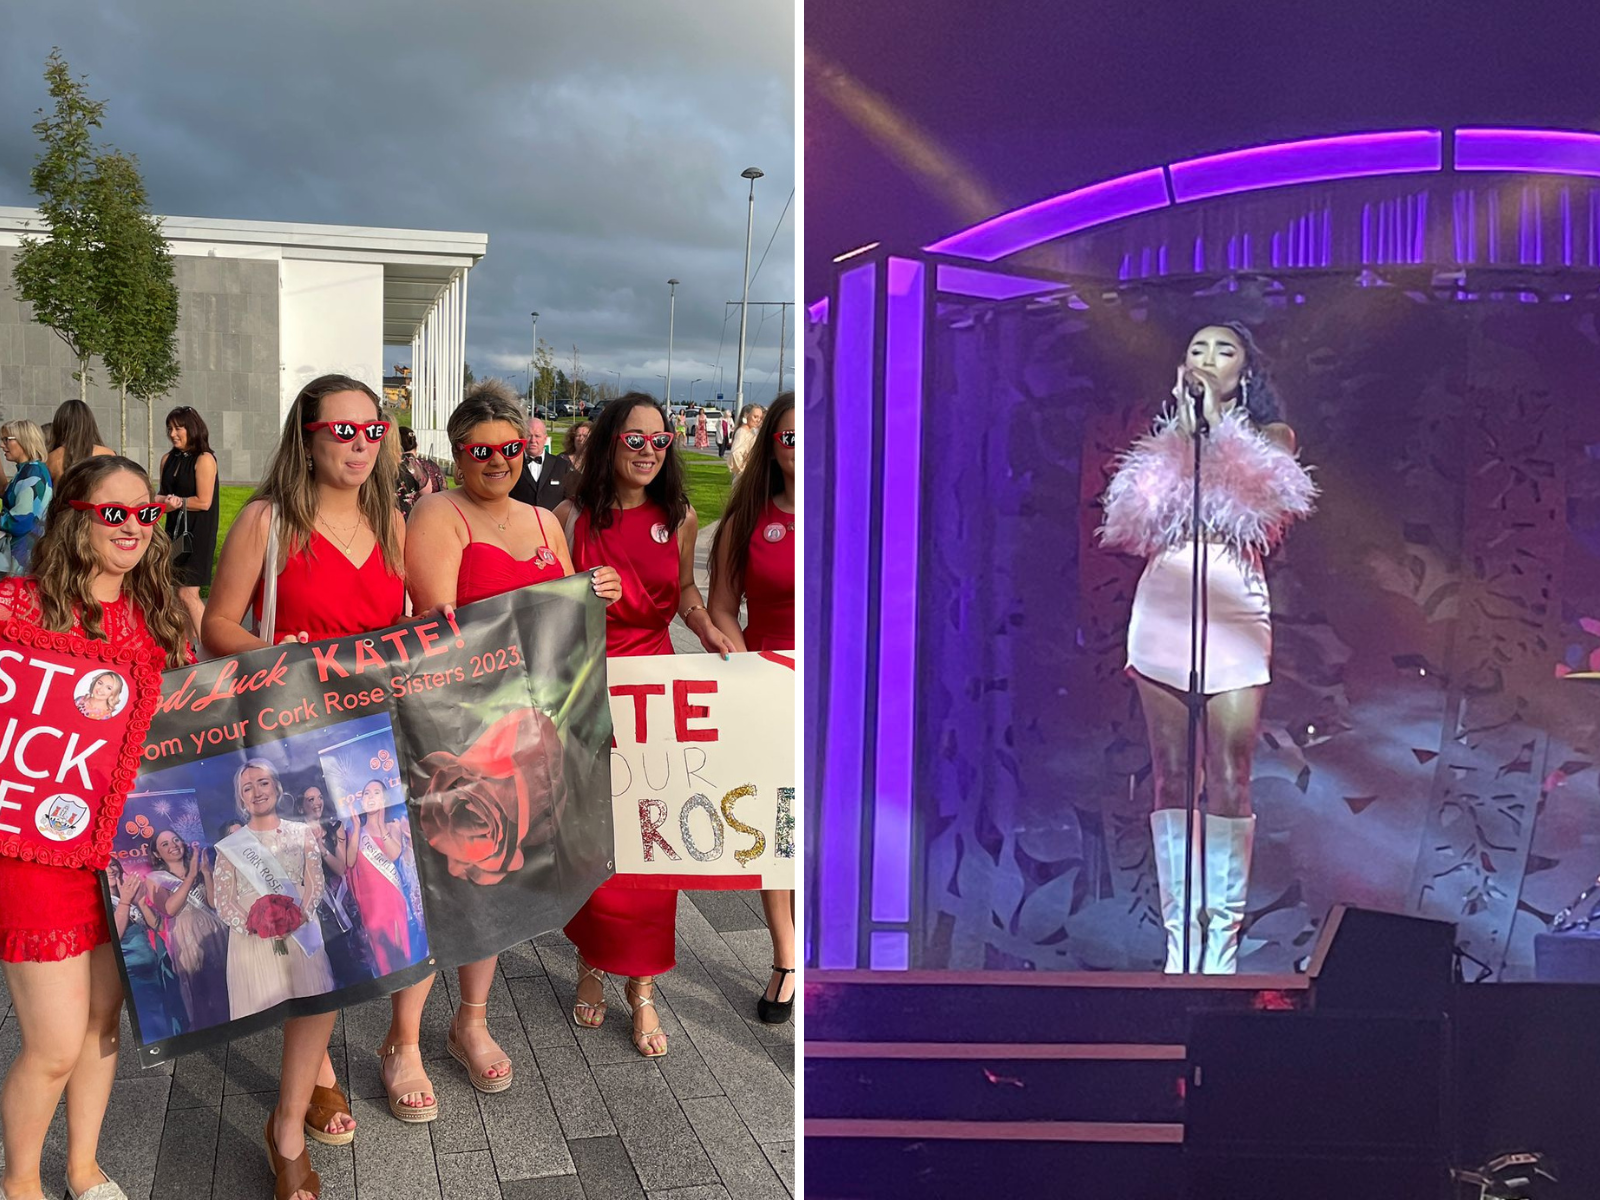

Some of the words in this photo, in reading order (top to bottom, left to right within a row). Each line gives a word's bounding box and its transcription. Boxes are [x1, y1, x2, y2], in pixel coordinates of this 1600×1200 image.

[189, 719, 249, 754] your
[257, 698, 319, 731] Cork
[323, 687, 385, 714] Rose
[390, 667, 465, 698] Sisters
[469, 645, 521, 678] 2023
[190, 651, 288, 712] Luck
[311, 618, 465, 683] KATE!
[608, 679, 718, 748] TE
[242, 847, 264, 869] CORK
[260, 867, 283, 893] ROSE
